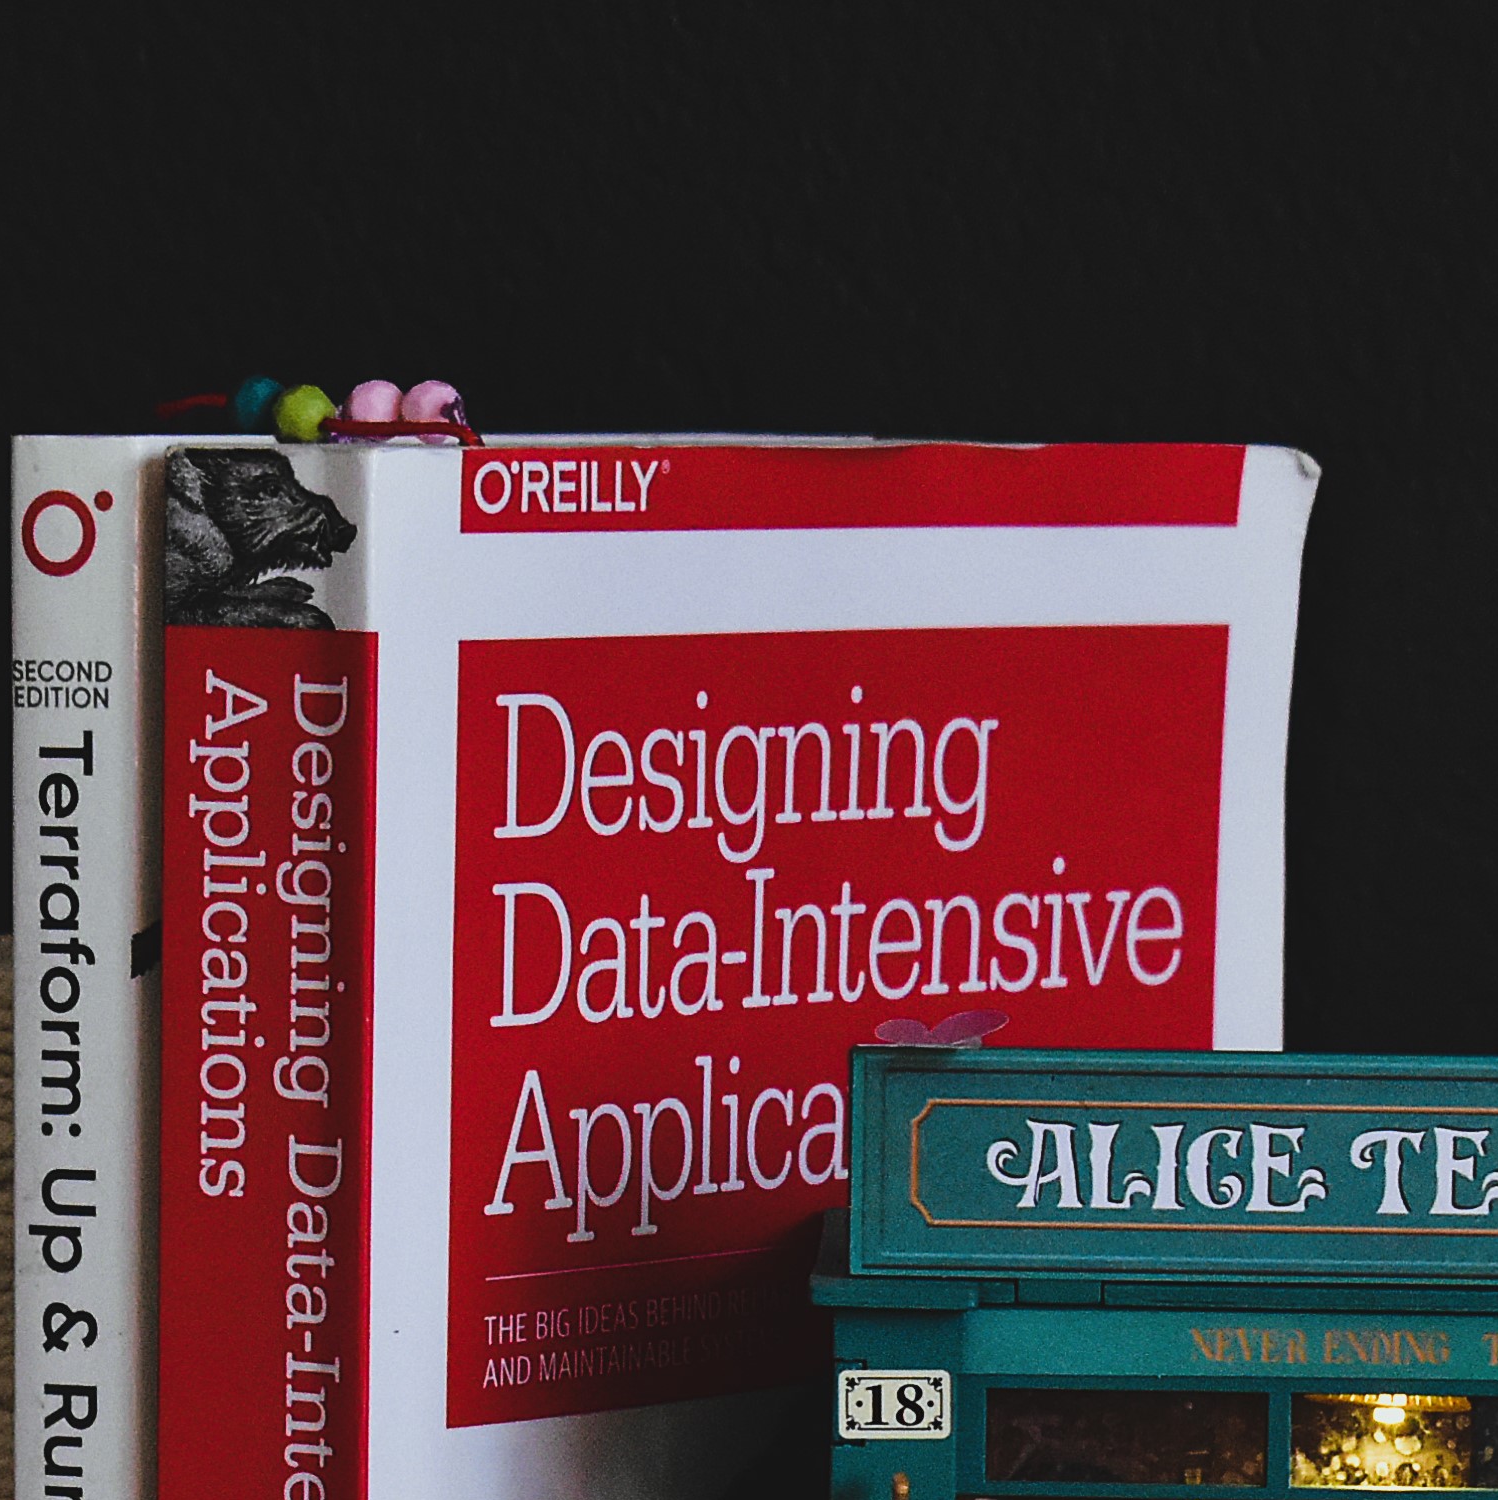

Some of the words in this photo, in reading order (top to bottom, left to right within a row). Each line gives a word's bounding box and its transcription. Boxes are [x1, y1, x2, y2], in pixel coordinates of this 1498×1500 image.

[12, 659, 113, 683] SECOND
[14, 686, 109, 709] EDITION
[494, 686, 998, 864] Designing
[38, 730, 96, 1138] Terraform:
[189, 668, 268, 1198] Applications
[273, 673, 348, 1108] Designing
[489, 857, 1184, 1028] Data-Intensive
[483, 1055, 848, 1243] Applica
[987, 1119, 1326, 1213] ALICE
[28, 1168, 97, 1274] Up
[42, 1301, 98, 1354] &
[483, 1356, 531, 1389] AND
[538, 1339, 692, 1381] MAINTAINABLE
[484, 1312, 527, 1346] THE
[535, 1308, 571, 1340] BIG
[577, 1299, 640, 1336] IDEAS
[647, 1292, 722, 1329] BEHIND
[1191, 1327, 1307, 1364] NEVER
[1322, 1330, 1450, 1366] ENDING
[864, 1384, 925, 1427] 18
